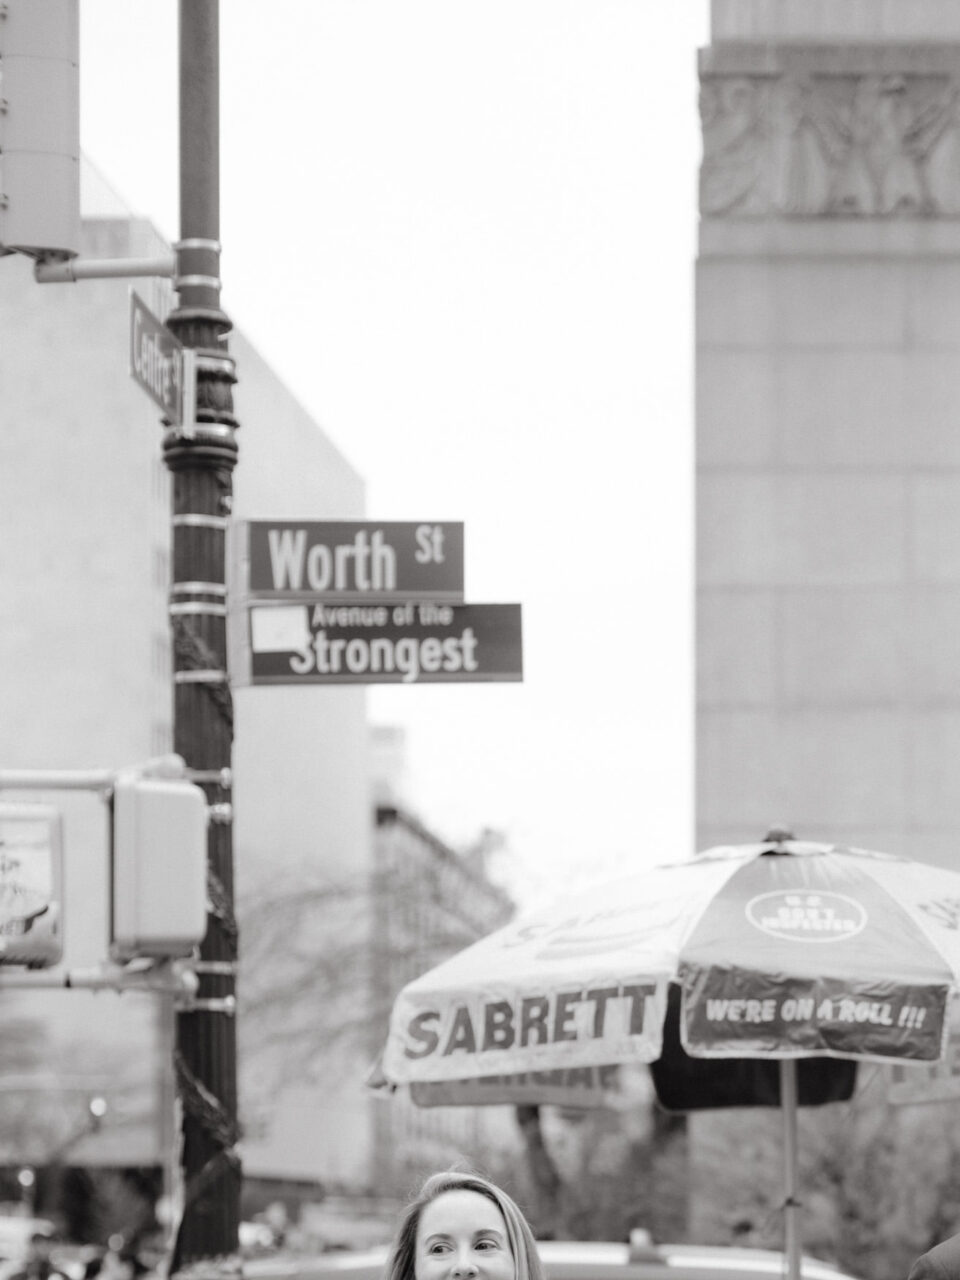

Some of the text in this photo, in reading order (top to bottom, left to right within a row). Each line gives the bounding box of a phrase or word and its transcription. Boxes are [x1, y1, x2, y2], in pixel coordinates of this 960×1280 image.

[268, 524, 445, 591] Worth St
[311, 602, 454, 627] Avenue of the
[289, 628, 478, 684] Strongest
[404, 984, 657, 1060] SABRETT
[706, 998, 777, 1024] WE'RE
[780, 999, 815, 1022] ON
[816, 999, 833, 1021] A
[838, 1001, 894, 1027] ROLL
